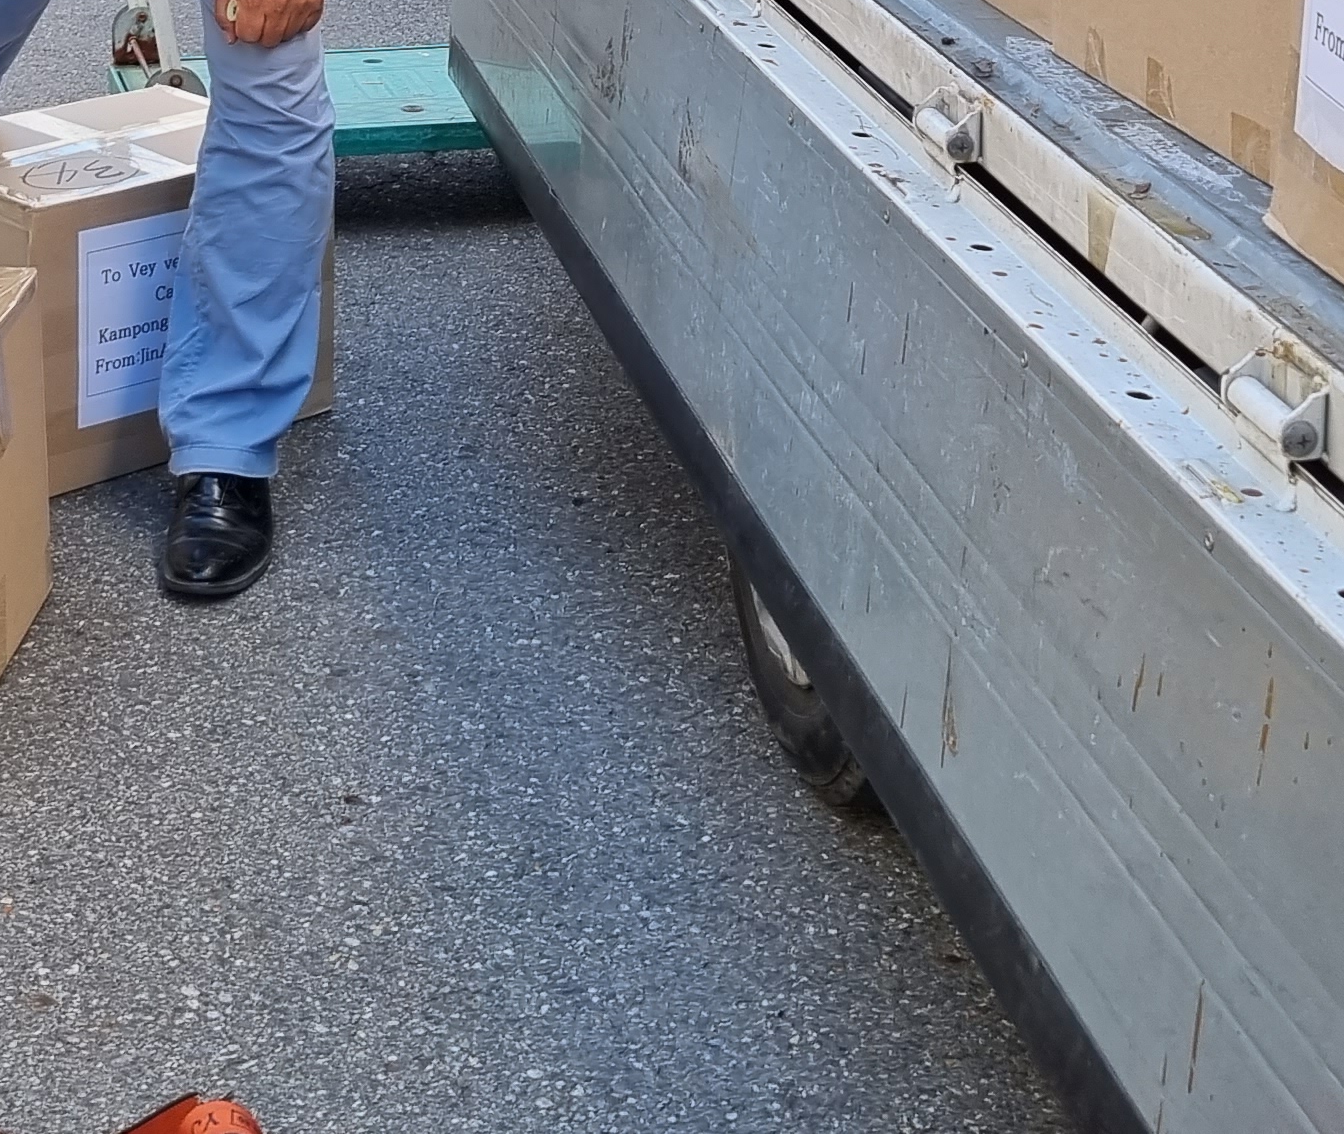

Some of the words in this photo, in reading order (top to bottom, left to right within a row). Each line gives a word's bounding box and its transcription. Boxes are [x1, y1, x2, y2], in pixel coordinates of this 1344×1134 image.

[101, 268, 122, 285] To
[128, 261, 158, 282] Vey
[163, 256, 180, 271] ve
[98, 316, 169, 346] Kampong
